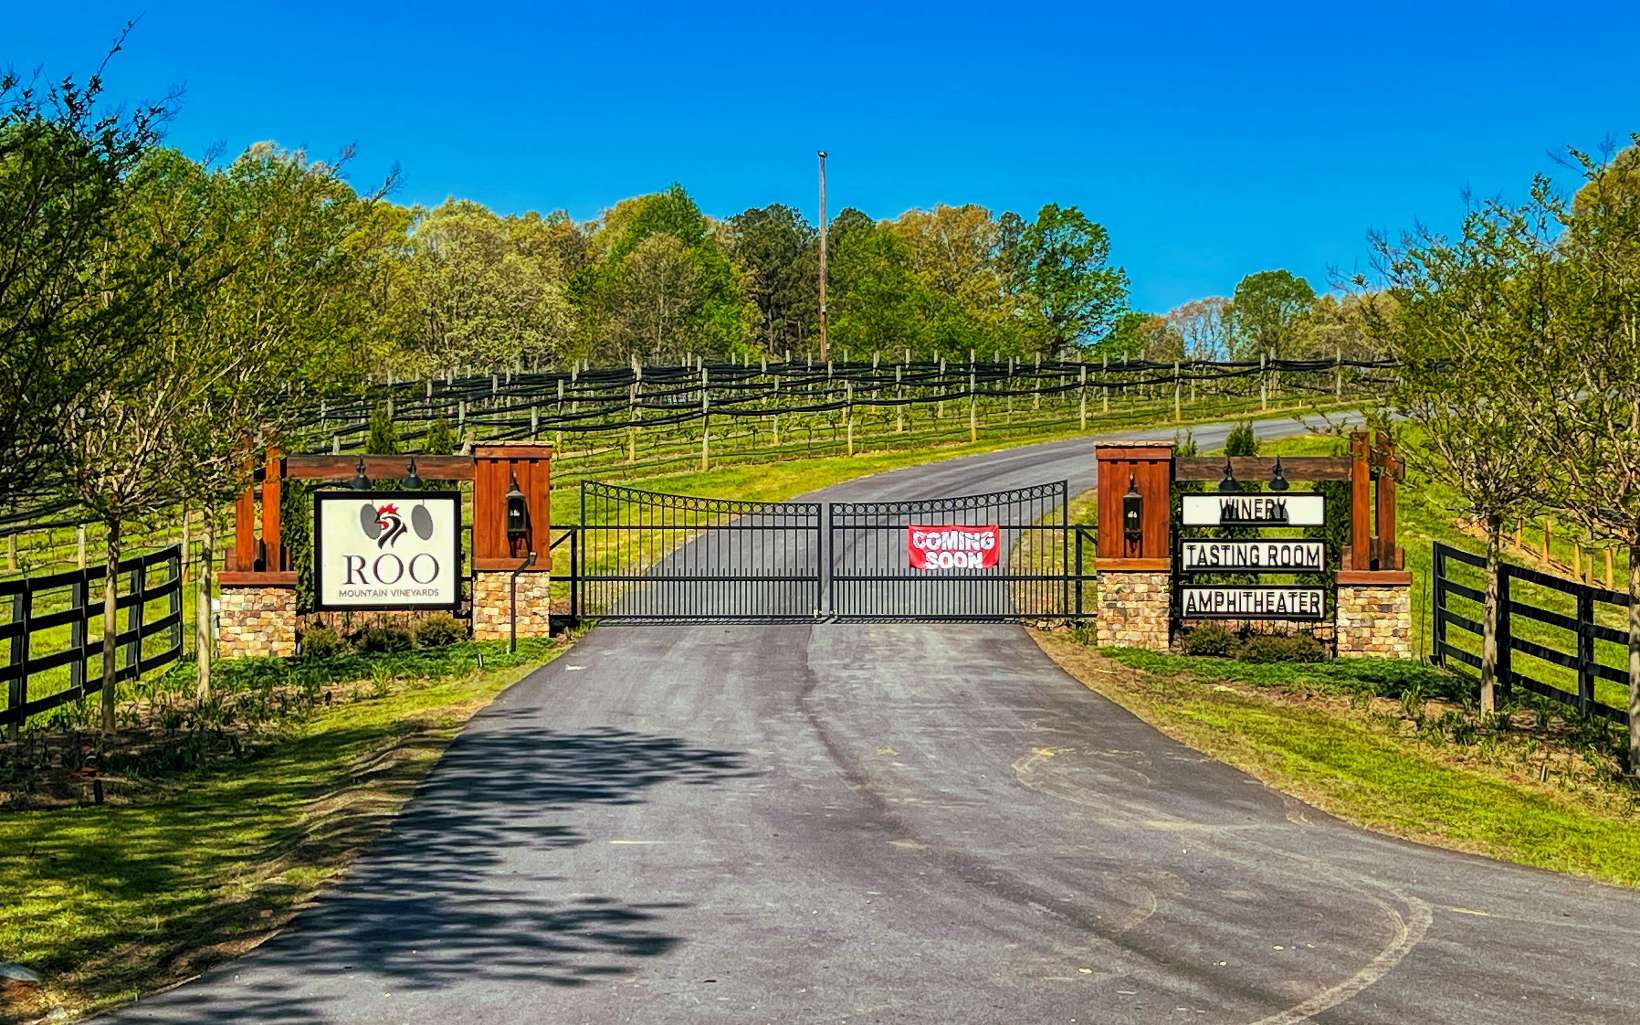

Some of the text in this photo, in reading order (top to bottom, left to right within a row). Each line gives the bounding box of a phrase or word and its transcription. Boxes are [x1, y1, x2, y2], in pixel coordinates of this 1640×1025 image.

[1219, 498, 1287, 520] WINERY
[913, 531, 994, 550] COMING
[925, 552, 983, 569] SOON
[1186, 545, 1320, 566] TASTING ROOM
[342, 553, 440, 585] ROO
[338, 588, 439, 598] MOUNTAIN VINEYARDS
[1186, 591, 1320, 613] AMPHITHEATER
